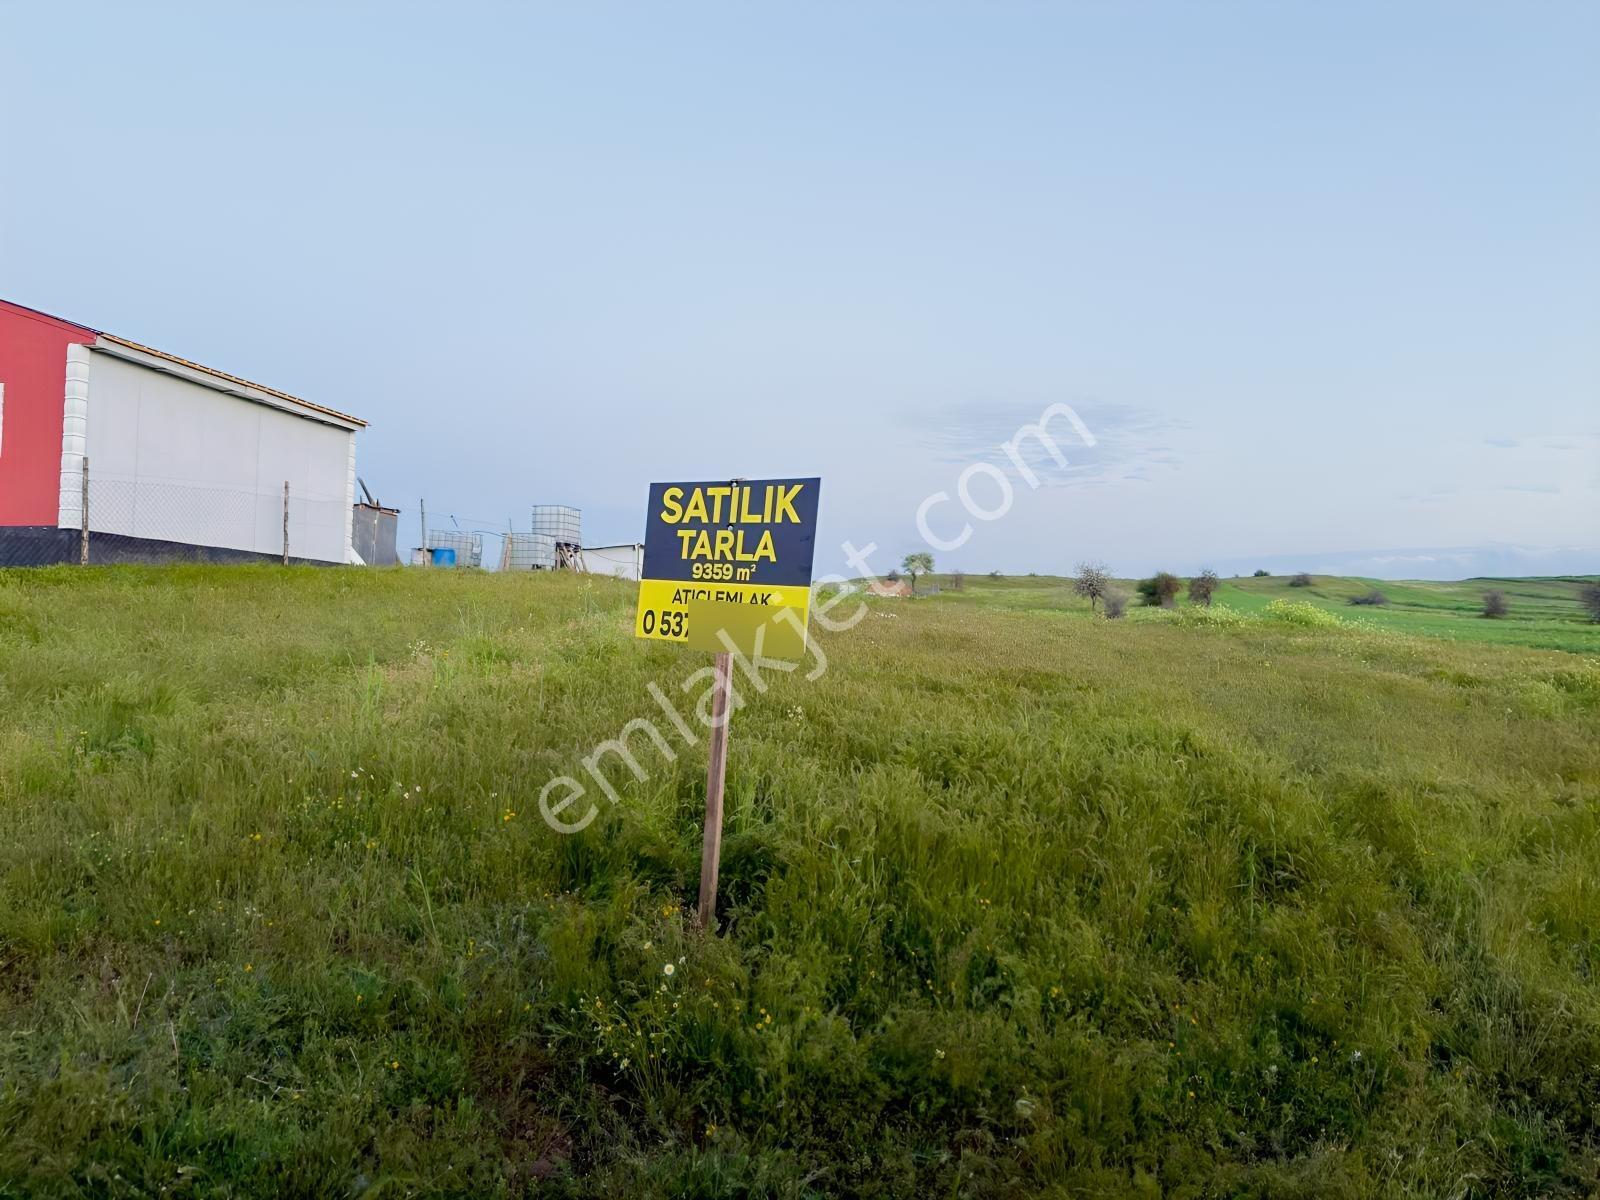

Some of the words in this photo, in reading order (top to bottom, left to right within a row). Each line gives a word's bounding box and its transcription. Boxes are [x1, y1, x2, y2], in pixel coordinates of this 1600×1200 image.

[660, 484, 804, 524] SATILIK
[677, 529, 777, 562] TARLA
[692, 562, 734, 580] 9359
[643, 609, 656, 635] 0
